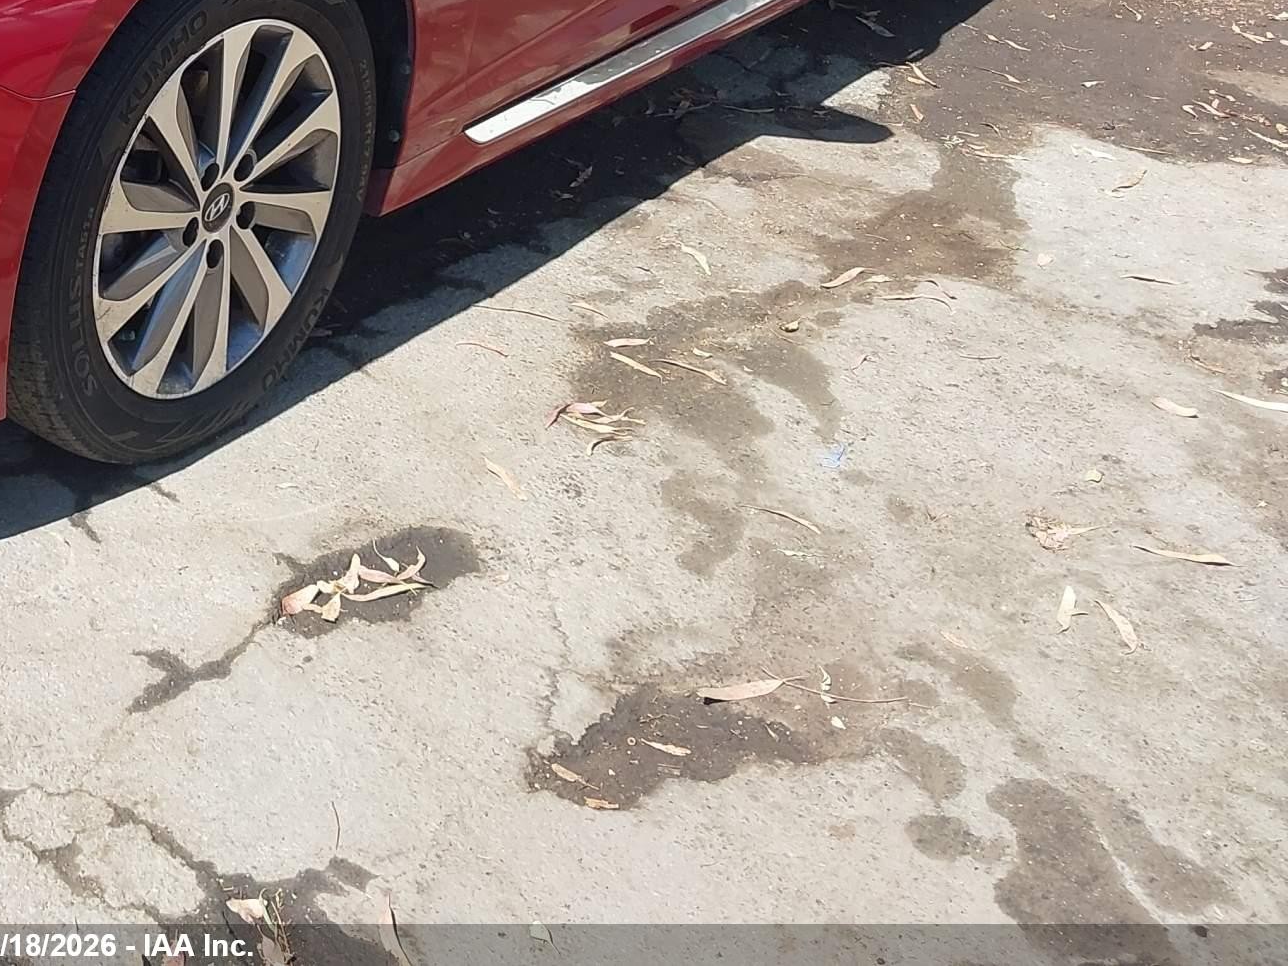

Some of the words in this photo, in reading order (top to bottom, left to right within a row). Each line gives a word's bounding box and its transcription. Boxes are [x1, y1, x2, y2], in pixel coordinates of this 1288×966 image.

[118, 10, 208, 127] KUMHO
[69, 274, 98, 397] SOLUS
[263, 288, 332, 393] KUMHO
